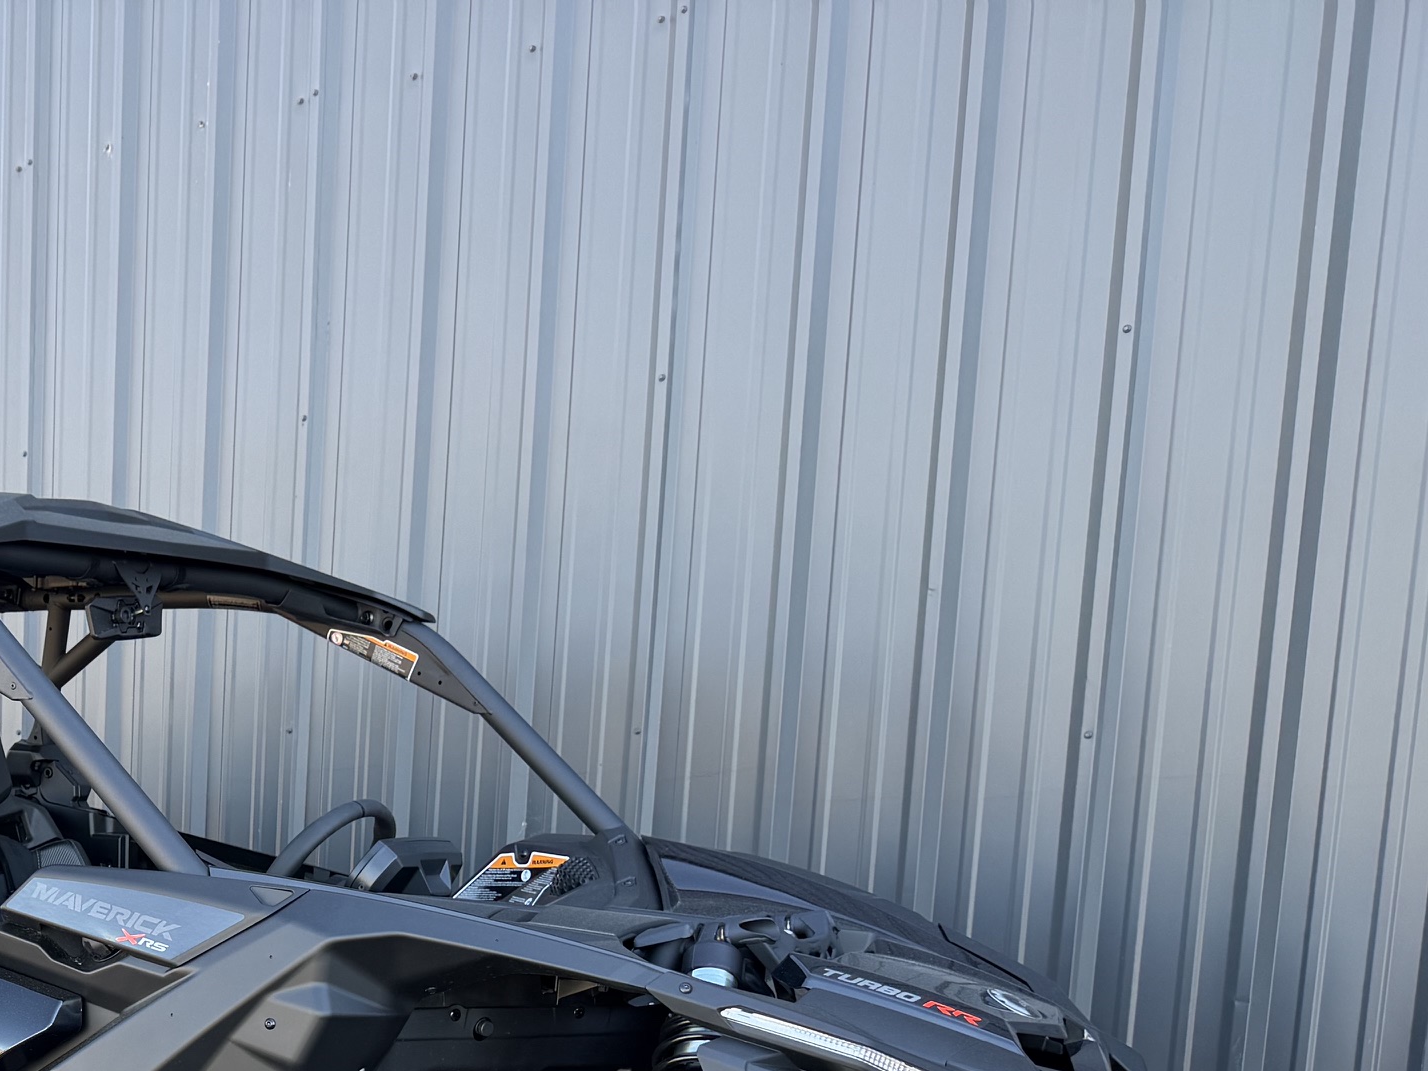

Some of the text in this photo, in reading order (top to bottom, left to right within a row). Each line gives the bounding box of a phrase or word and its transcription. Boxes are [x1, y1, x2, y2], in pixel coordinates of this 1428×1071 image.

[31, 881, 181, 941] MAVERICK
[115, 928, 170, 952] XRS
[822, 968, 983, 1027] TURBO RR
